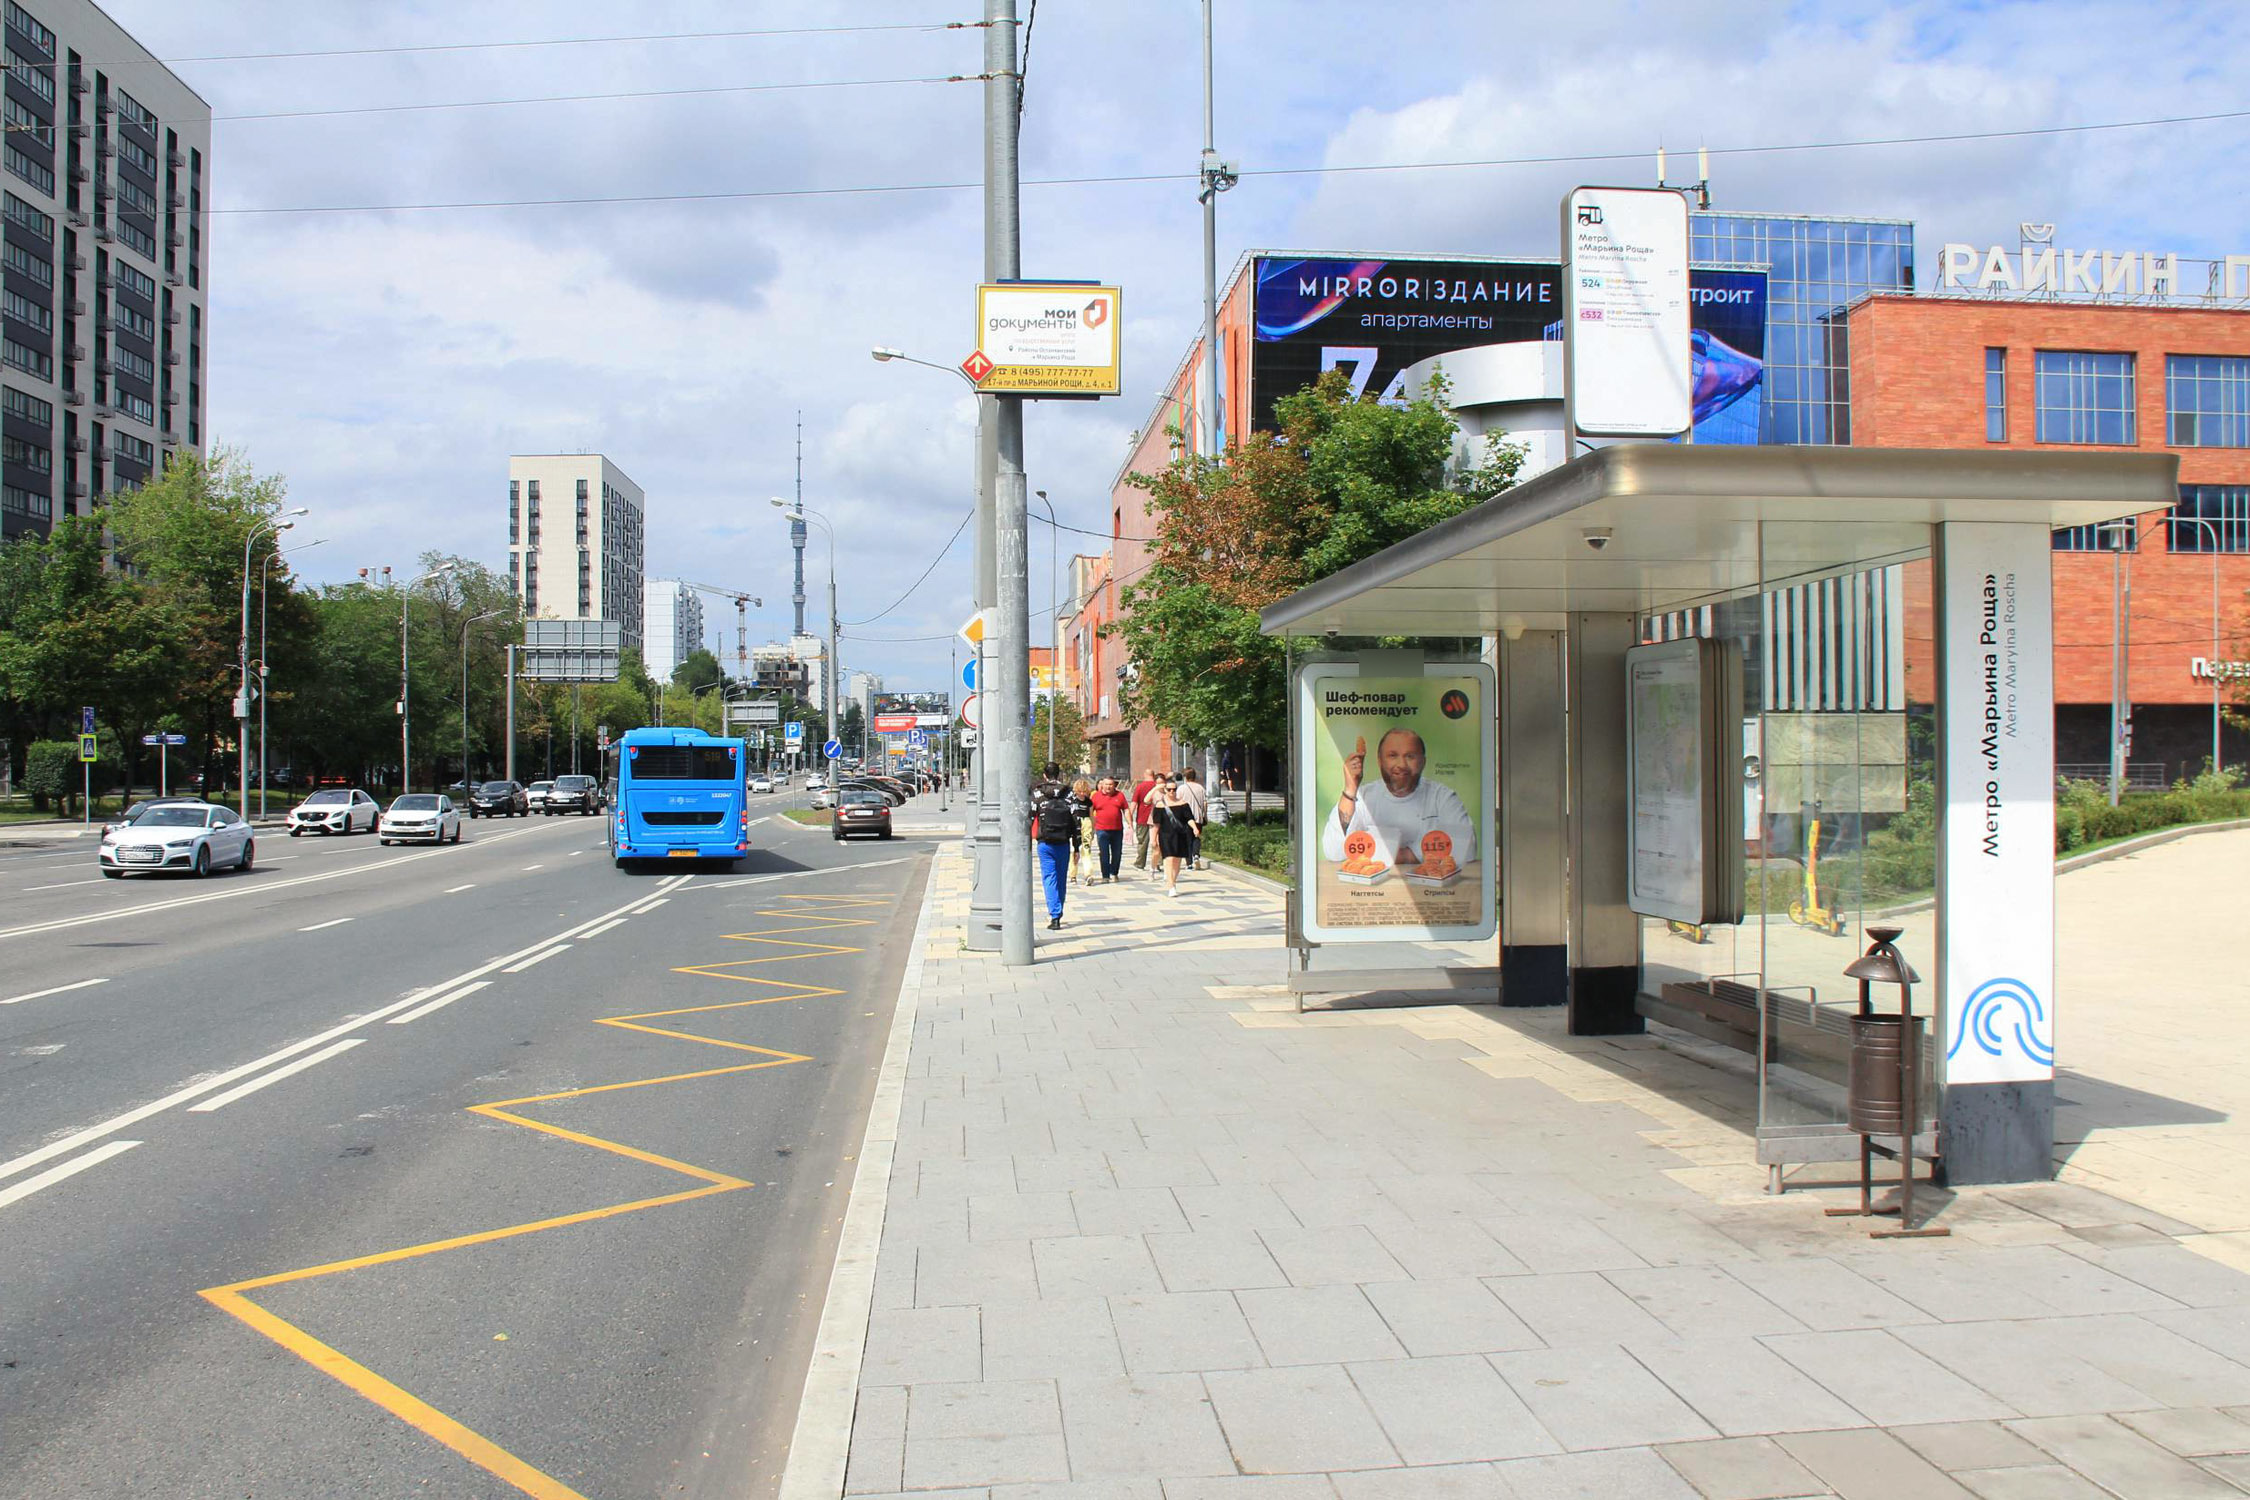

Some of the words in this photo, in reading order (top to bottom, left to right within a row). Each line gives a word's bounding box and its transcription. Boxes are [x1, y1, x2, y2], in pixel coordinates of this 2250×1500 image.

[1578, 234, 1608, 243] Метро
[1578, 244, 1624, 253] «Марьина
[1625, 245, 1654, 254] Роща»
[1944, 223, 2177, 296] РАЙКИН
[1582, 278, 1600, 288] 524
[1688, 287, 1754, 307] троит
[1045, 309, 1077, 319] мои
[1580, 311, 1602, 320] с532
[989, 318, 1077, 332] документы
[1360, 313, 1493, 331] апартаменты
[1011, 368, 1017, 376] 8
[1019, 368, 1044, 377] (495)
[1046, 369, 1094, 378] 777-77-77
[1017, 378, 1059, 387] МАРЬИНОЙ
[2003, 573, 2016, 623] Roscha
[1980, 573, 1999, 645] Роща»
[2004, 628, 2019, 689] Maryina
[1325, 690, 1406, 704] Шеф-повар
[1325, 705, 1419, 718] рекомендует
[1980, 653, 2002, 772] «Марьина
[2005, 693, 2017, 738] Metro
[1982, 780, 2002, 857] Метро
[1348, 843, 1366, 854] 69
[1424, 842, 1446, 851] 115
[1423, 889, 1456, 897] Стрипсы
